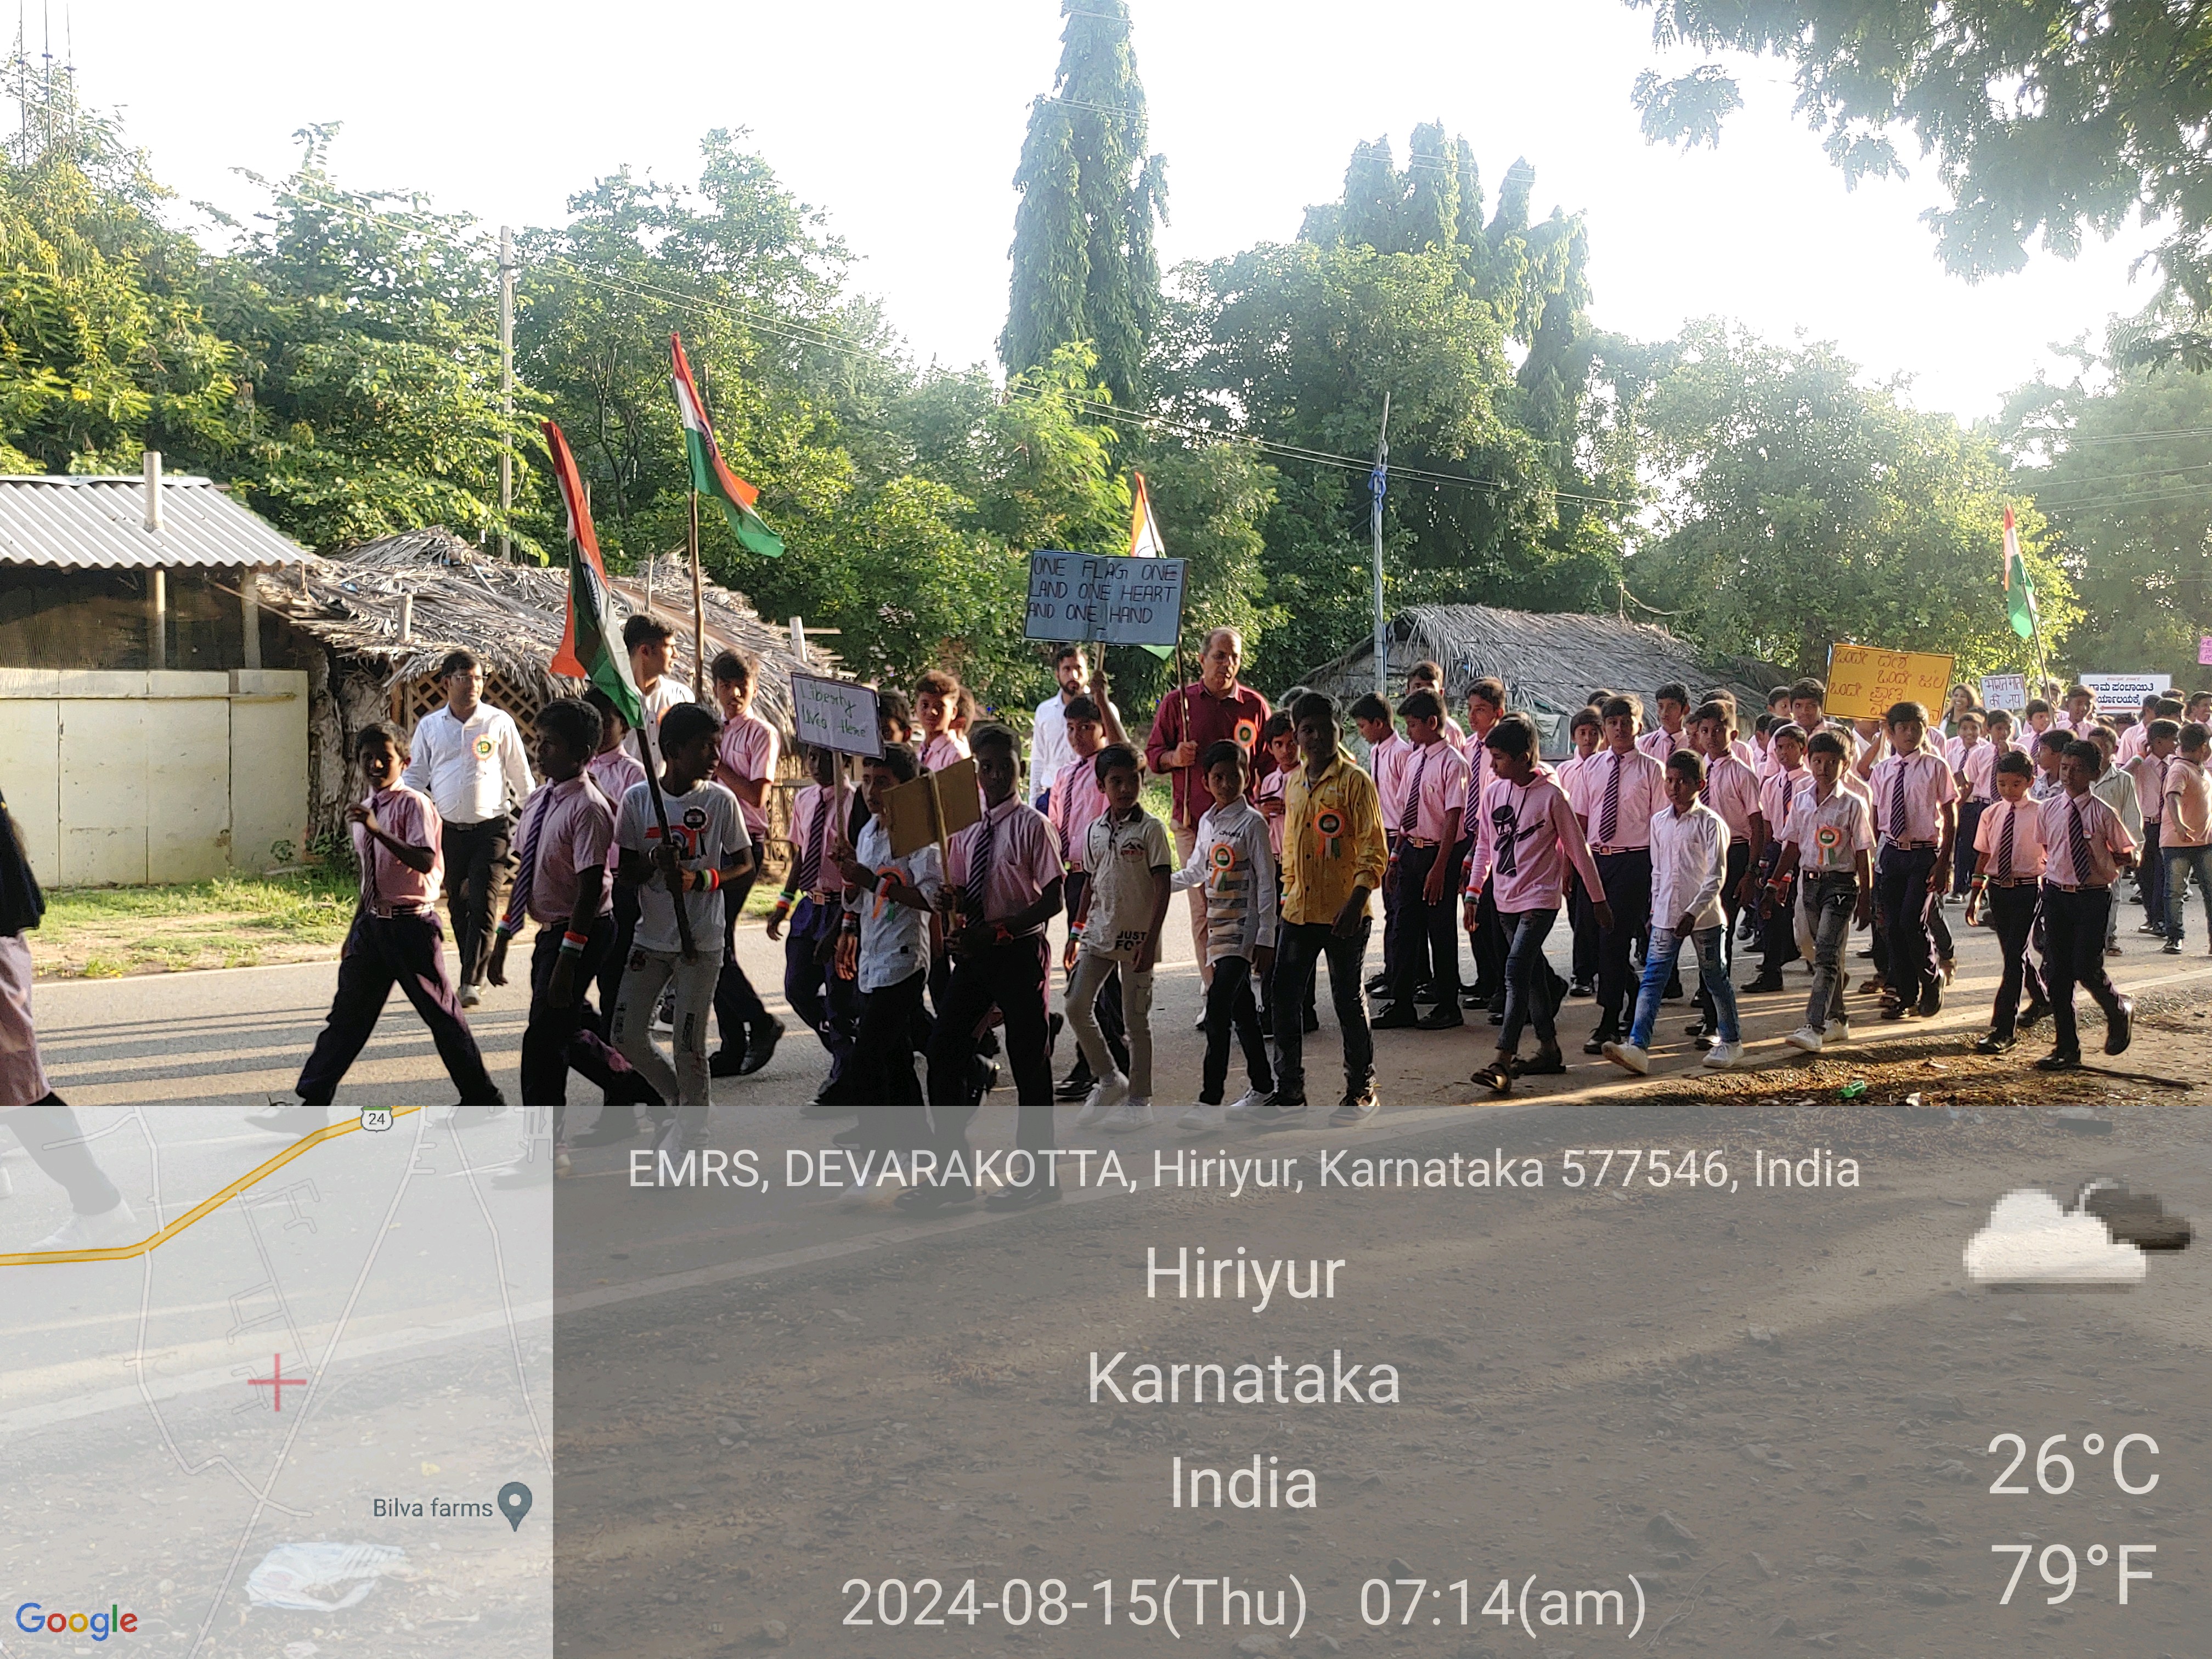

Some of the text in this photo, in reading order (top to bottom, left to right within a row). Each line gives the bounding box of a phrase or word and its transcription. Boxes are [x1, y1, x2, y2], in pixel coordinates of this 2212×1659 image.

[1034, 558, 1177, 581] ONE FLAG ONE
[1029, 581, 1178, 602] LAND ONE HEART
[1029, 602, 1153, 624] AND ONE HAND
[1116, 930, 1147, 940] JUST
